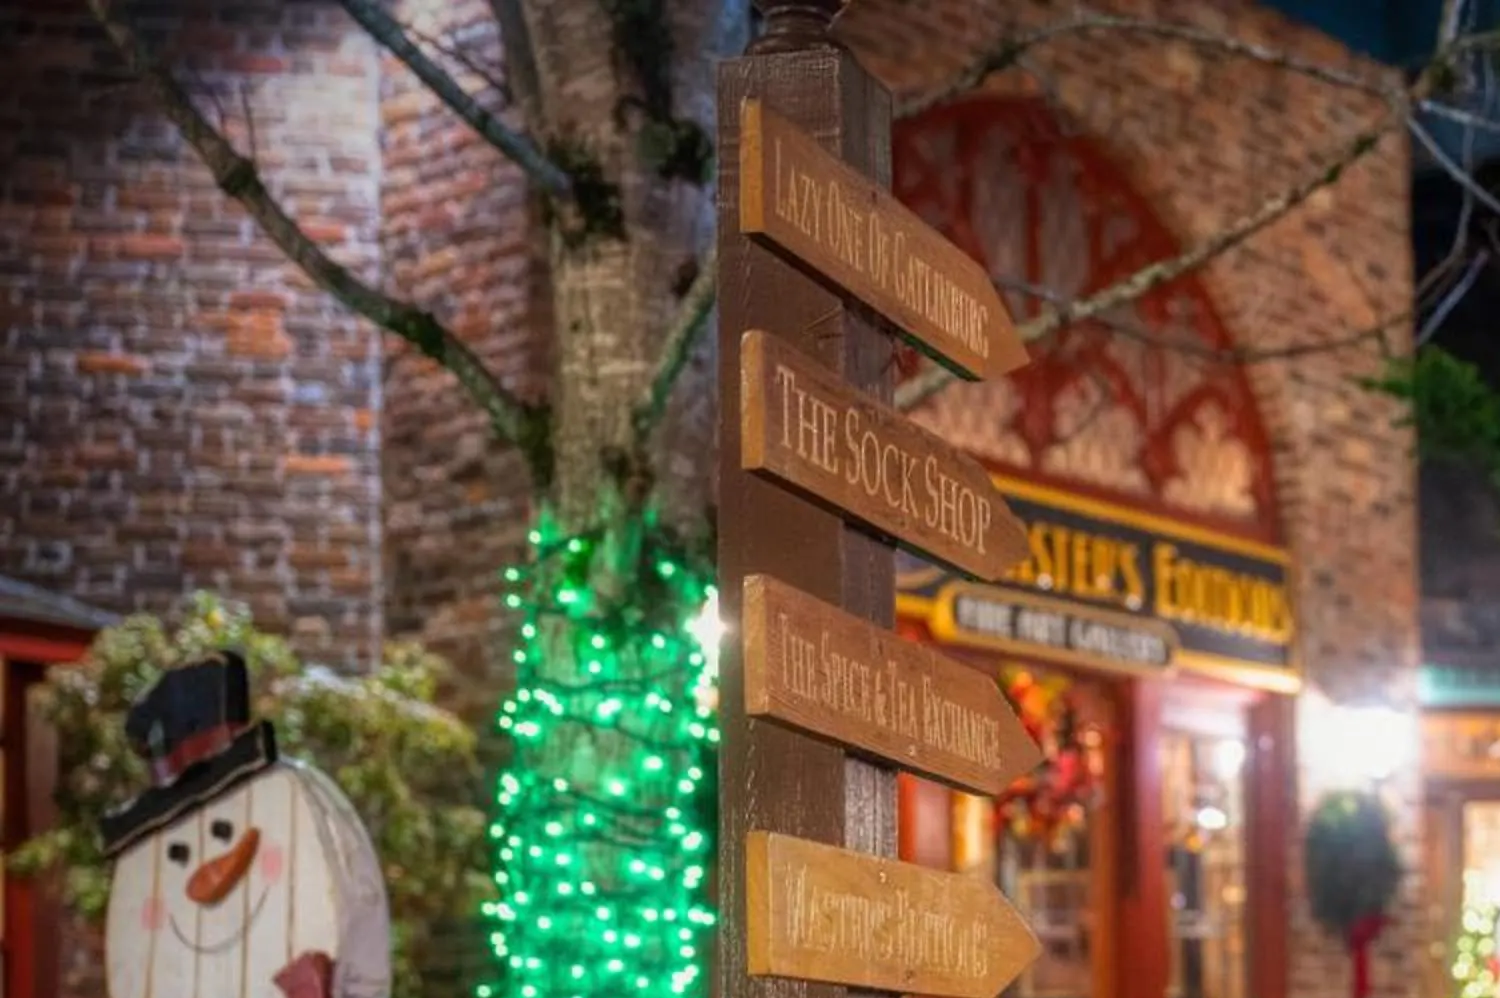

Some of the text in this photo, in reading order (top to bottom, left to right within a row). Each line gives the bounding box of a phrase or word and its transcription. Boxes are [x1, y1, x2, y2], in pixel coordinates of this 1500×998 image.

[775, 137, 820, 242] LAZY
[828, 181, 863, 272] ONE
[869, 211, 889, 288] OF
[776, 365, 991, 554] THE SOCK SHOP
[778, 613, 818, 702] THE
[821, 632, 872, 722] SPICE
[887, 660, 918, 740] TEA
[922, 674, 1001, 769] EXCHANGE
